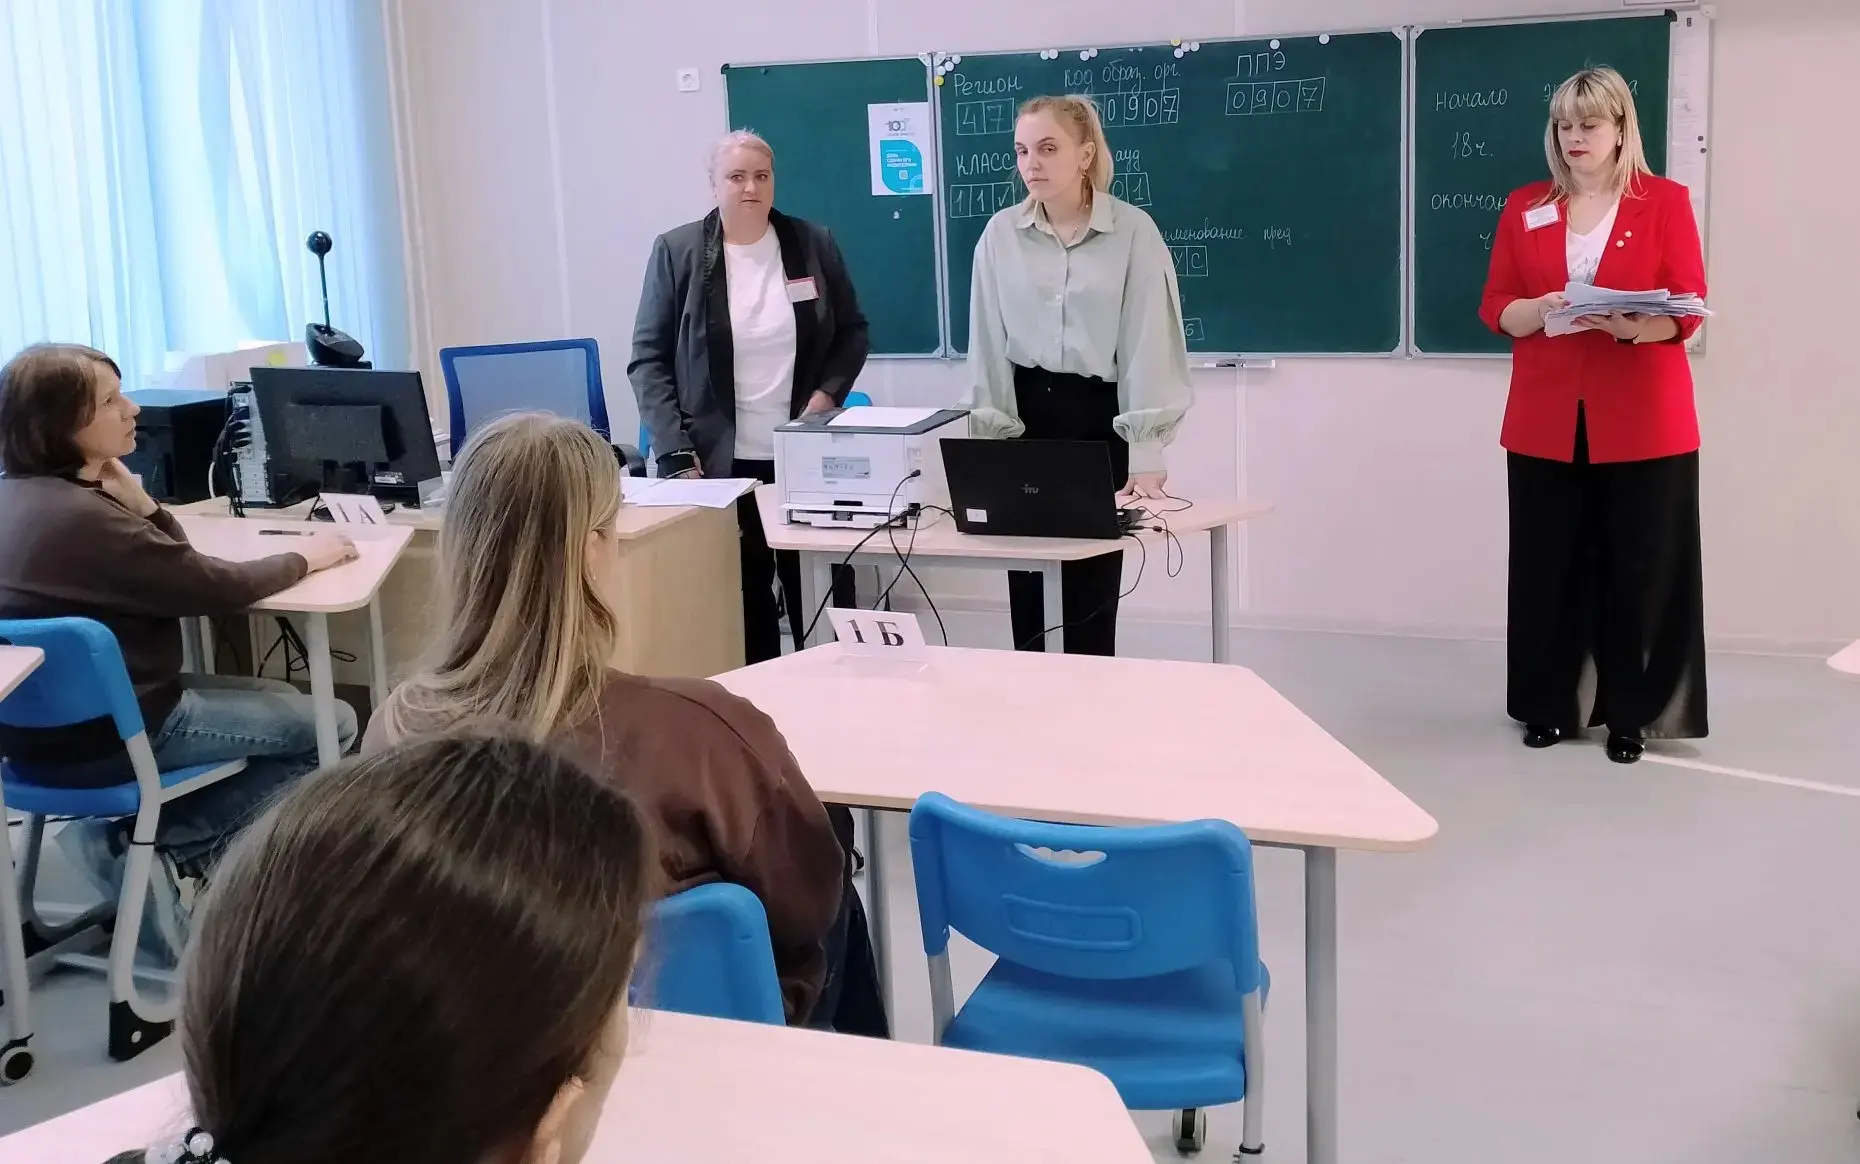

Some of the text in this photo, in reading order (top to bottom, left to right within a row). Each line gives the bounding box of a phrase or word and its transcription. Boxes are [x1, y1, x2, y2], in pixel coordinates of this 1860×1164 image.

[1237, 51, 1286, 77] ППЭ
[954, 73, 1023, 97] Регион
[1233, 86, 1318, 109] 0907
[963, 104, 1003, 134] 47
[1116, 149, 1140, 172] ауд
[847, 619, 904, 647] 1 Б
